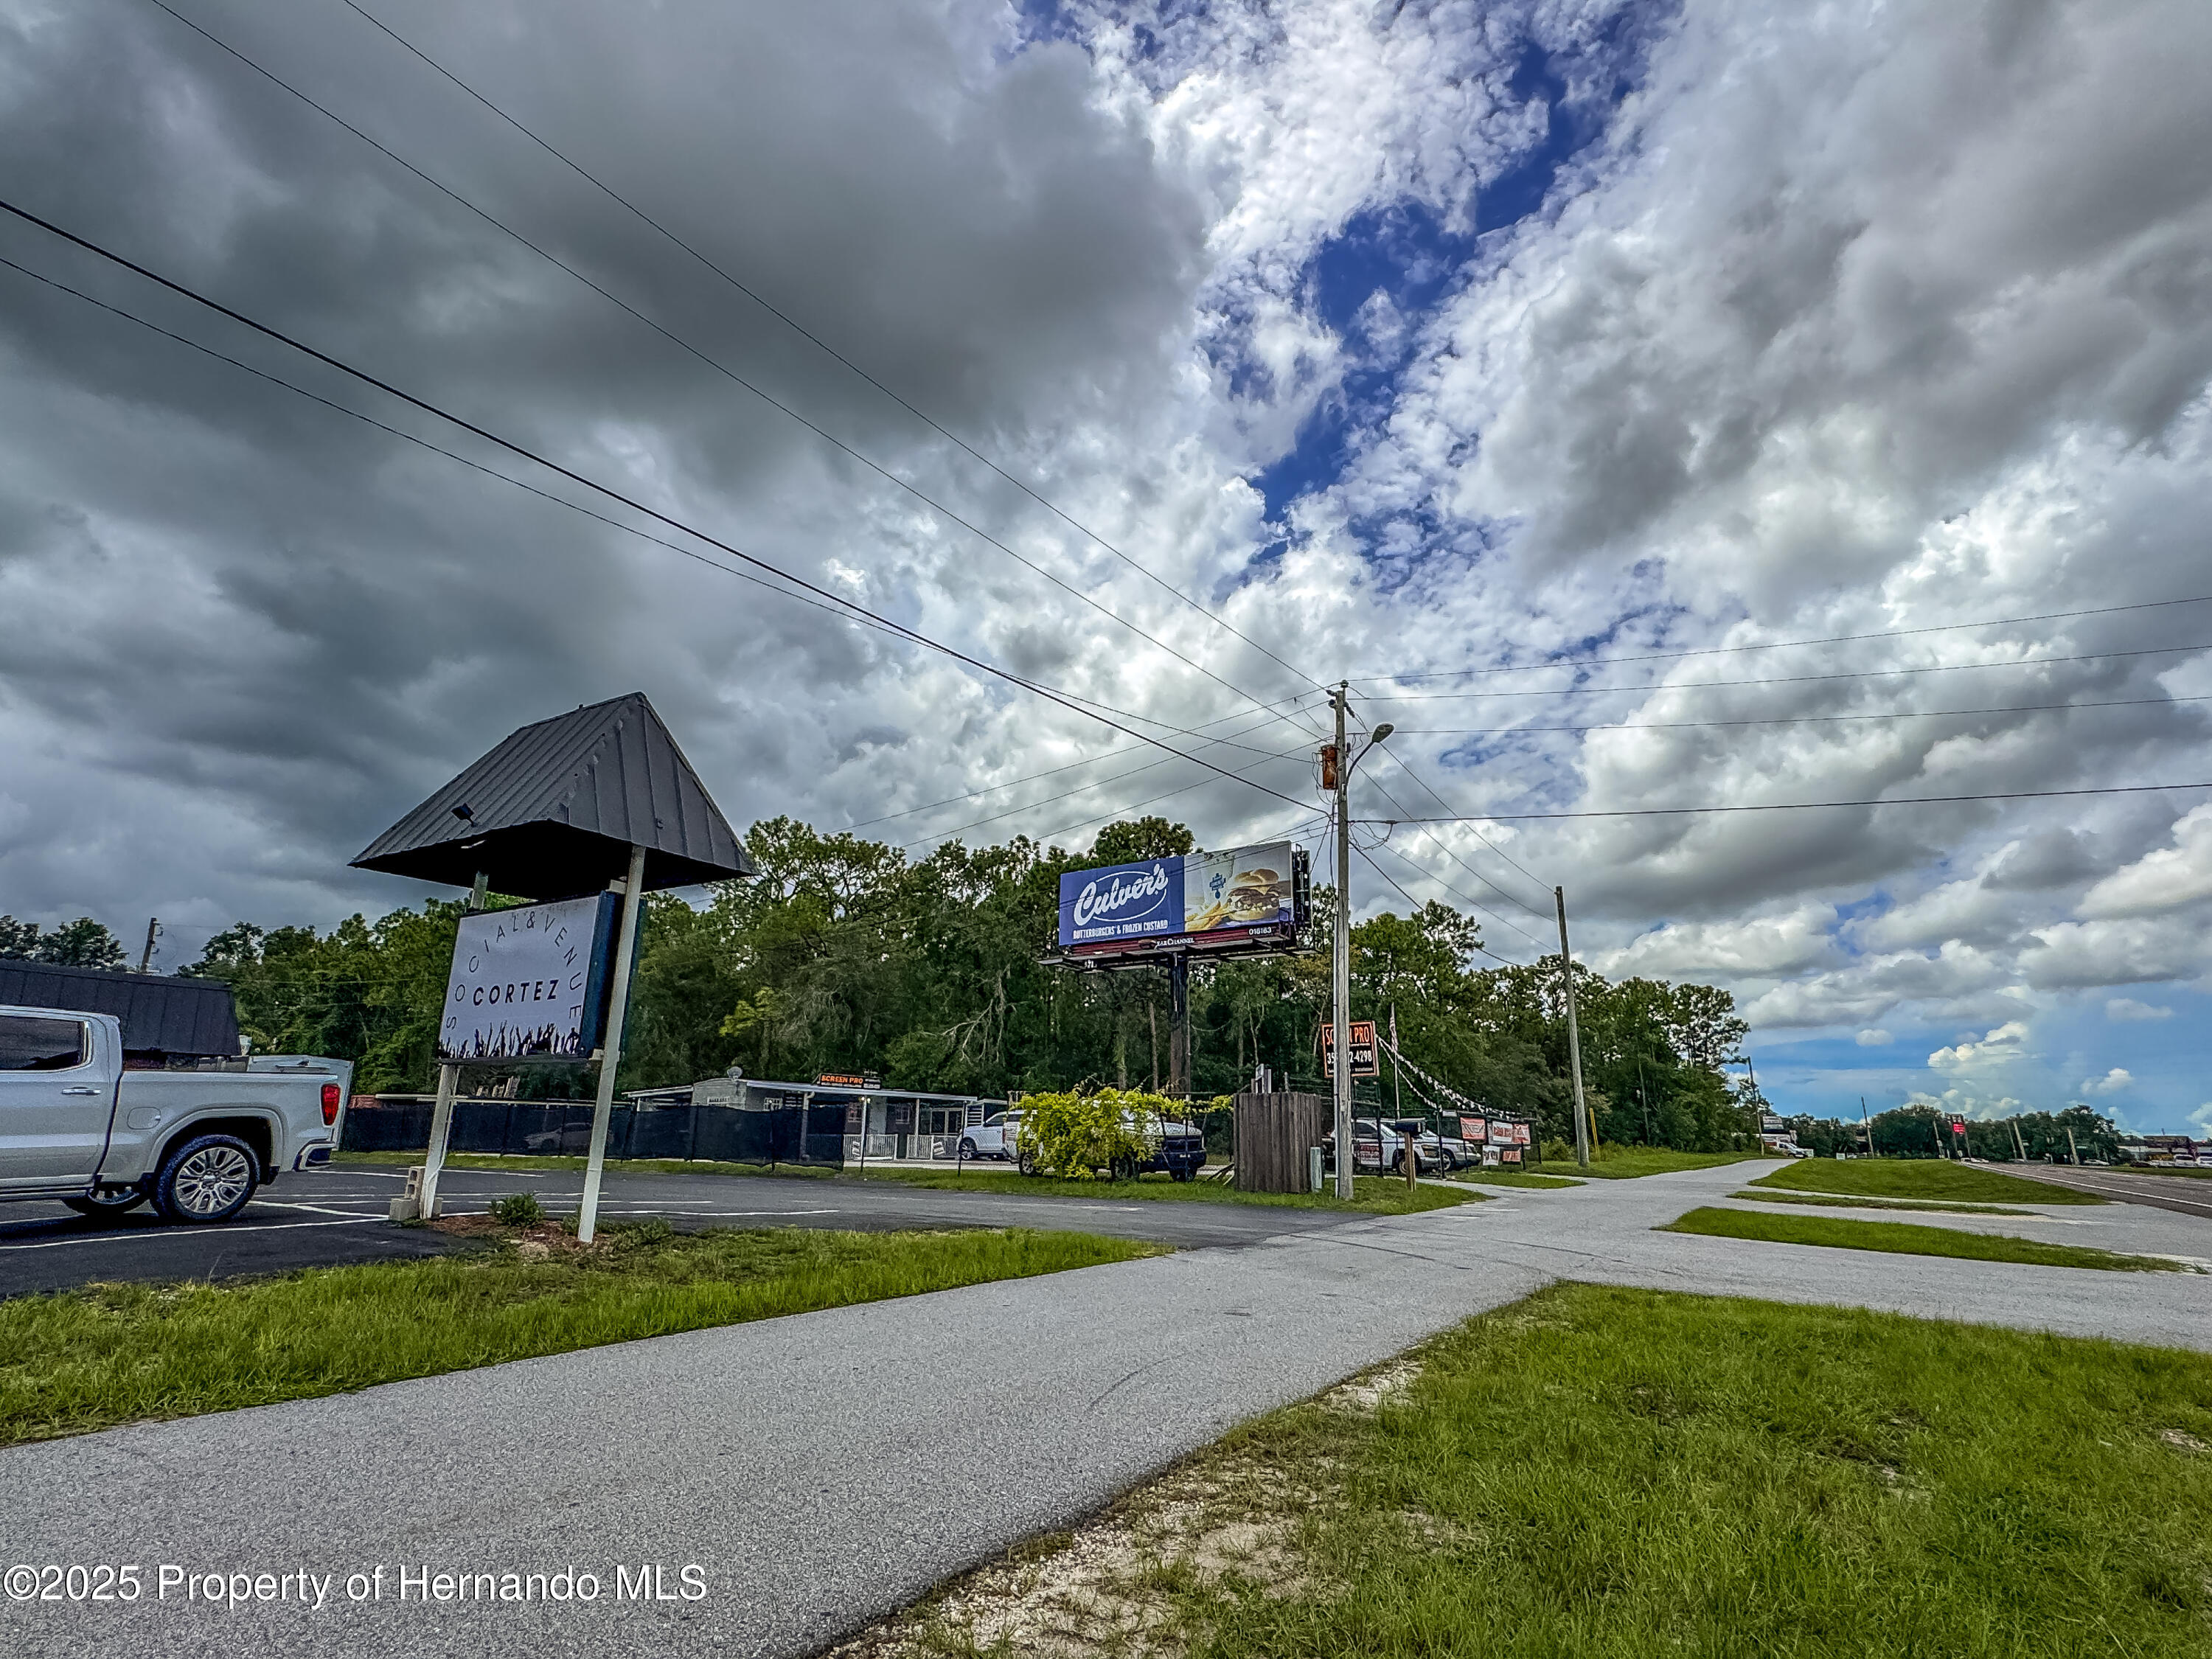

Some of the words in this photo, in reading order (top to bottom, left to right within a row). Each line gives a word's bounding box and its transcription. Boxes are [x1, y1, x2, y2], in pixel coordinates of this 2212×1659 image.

[1074, 863, 1169, 926] Culver's
[1122, 922, 1142, 934] FROZEN
[1143, 919, 1169, 932] CUSTARD
[473, 979, 559, 1006] CORTEZ
[1354, 1026, 1369, 1043] PRO
